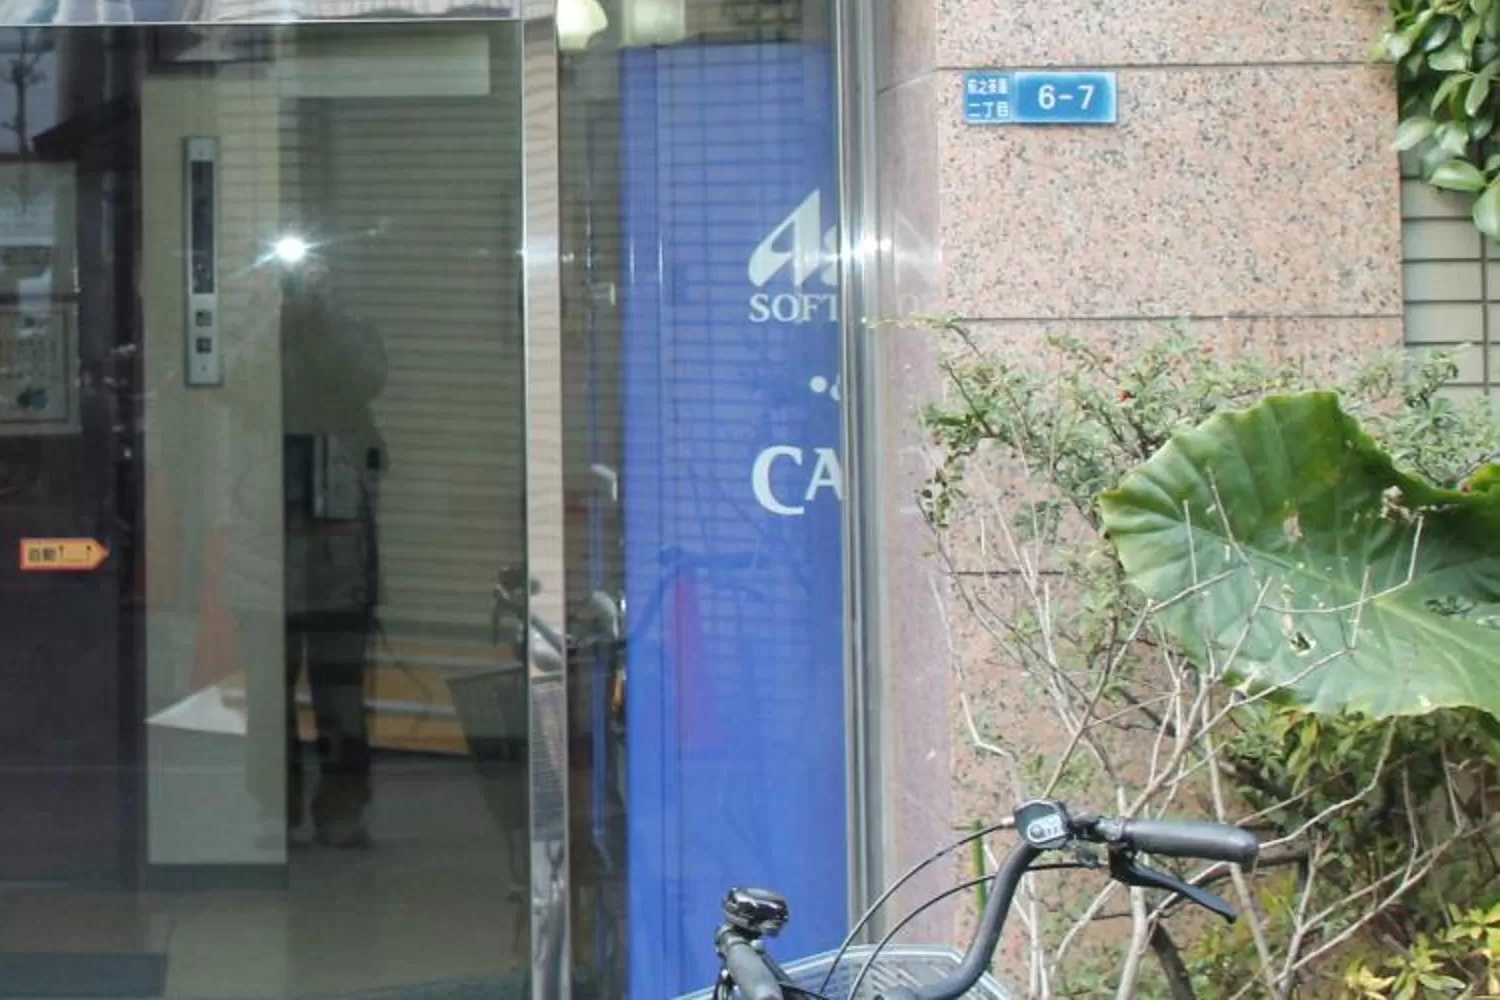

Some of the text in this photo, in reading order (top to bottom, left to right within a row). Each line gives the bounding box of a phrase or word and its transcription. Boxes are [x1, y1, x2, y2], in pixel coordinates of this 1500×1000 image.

[1037, 84, 1096, 111] 6-7
[967, 101, 1009, 118] 二丁目
